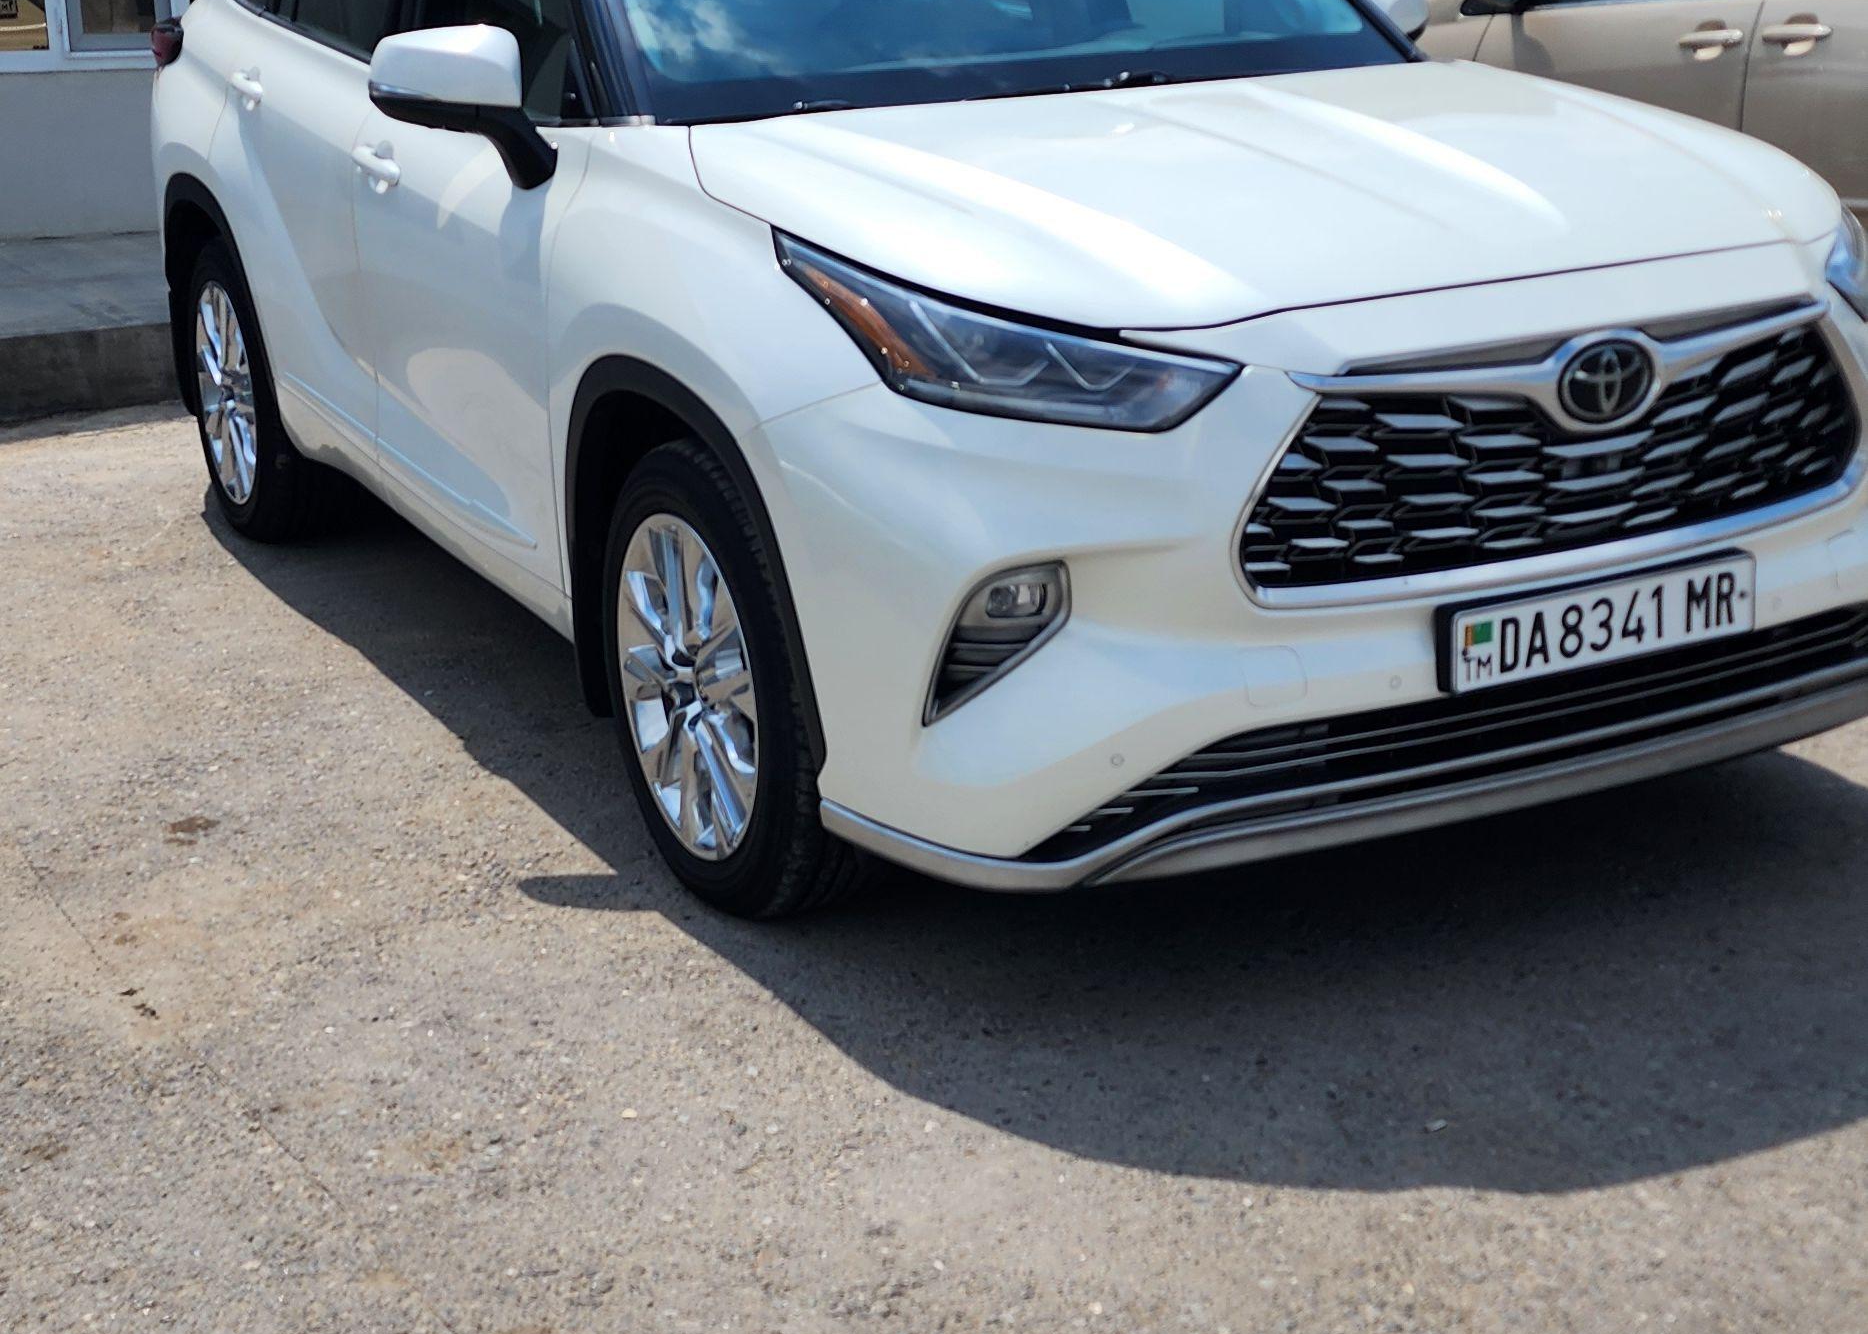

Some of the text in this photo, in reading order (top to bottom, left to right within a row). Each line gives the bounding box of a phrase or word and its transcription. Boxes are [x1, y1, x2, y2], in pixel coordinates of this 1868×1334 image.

[1500, 571, 1735, 674] DA8341 MR
[1463, 653, 1493, 682] TM
